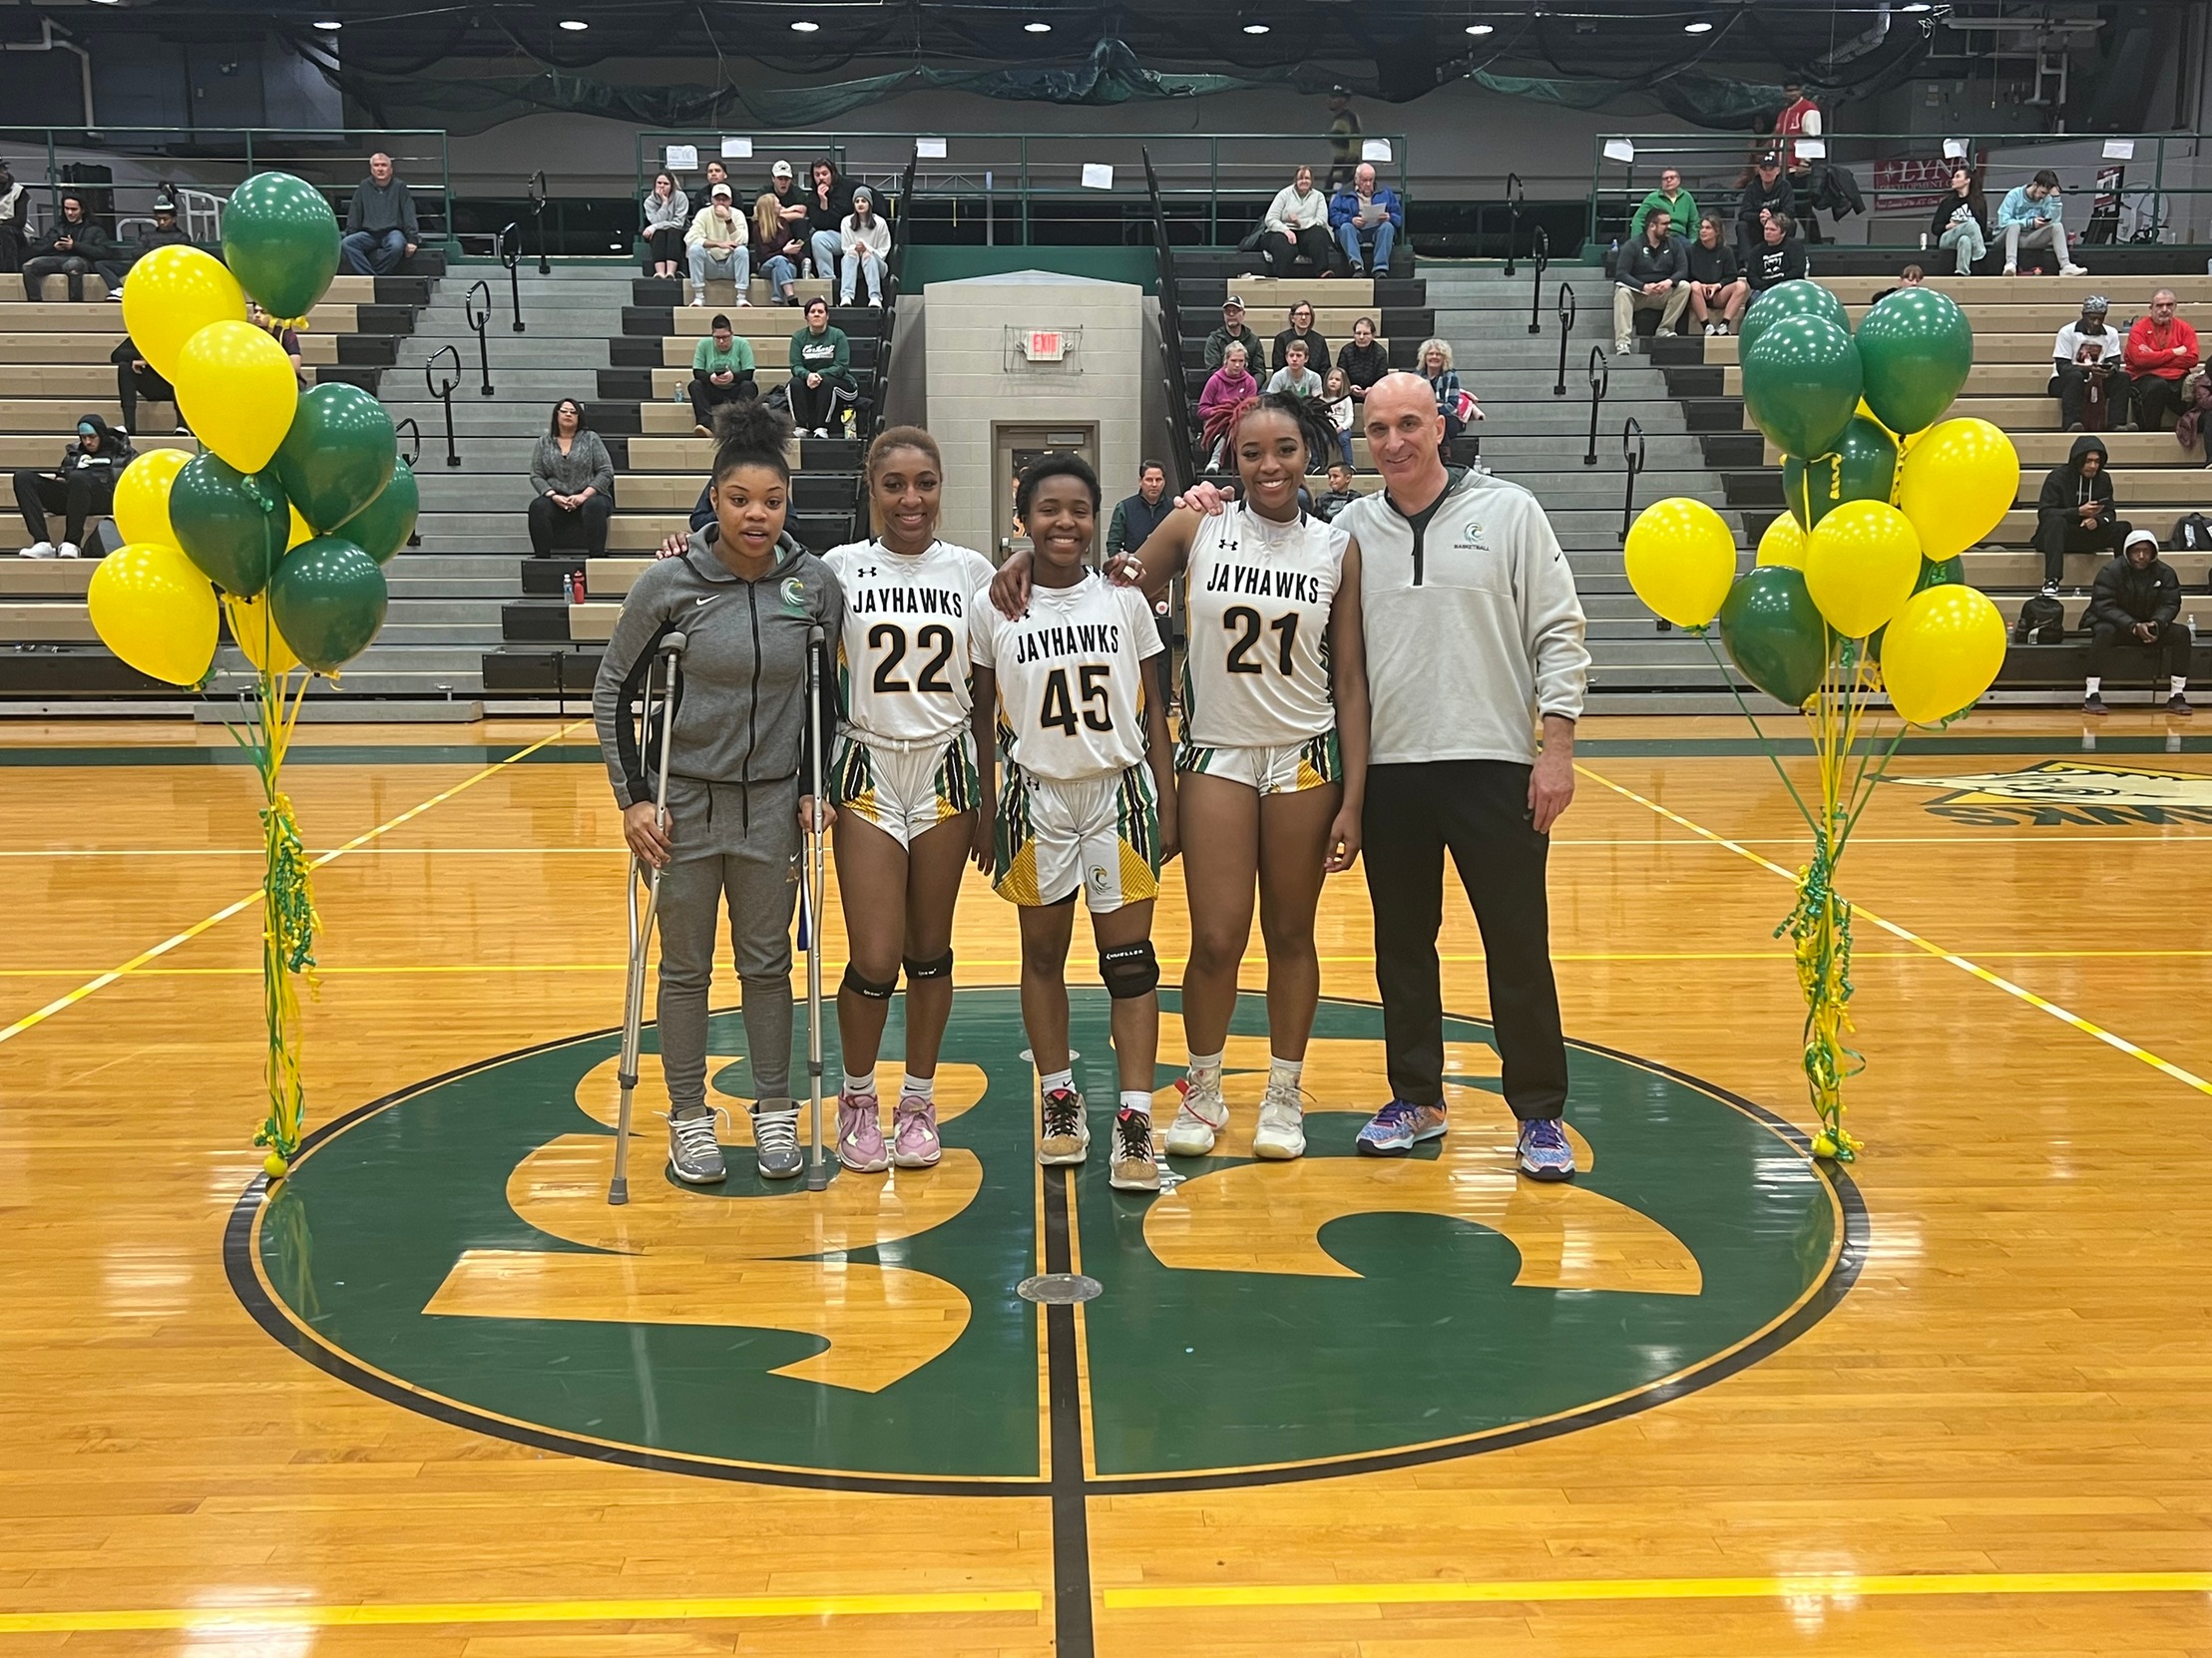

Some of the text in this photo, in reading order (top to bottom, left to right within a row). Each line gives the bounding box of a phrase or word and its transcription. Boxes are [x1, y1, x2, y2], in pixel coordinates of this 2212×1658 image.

[1033, 333, 1060, 353] EXIT
[853, 587, 963, 619] JAYHAWKS
[1206, 563, 1319, 605] JAYHAWKS
[867, 622, 955, 694] 22
[1017, 624, 1118, 664] JAYHAWKS
[1223, 605, 1299, 676] 21
[1039, 663, 1114, 737] 45
